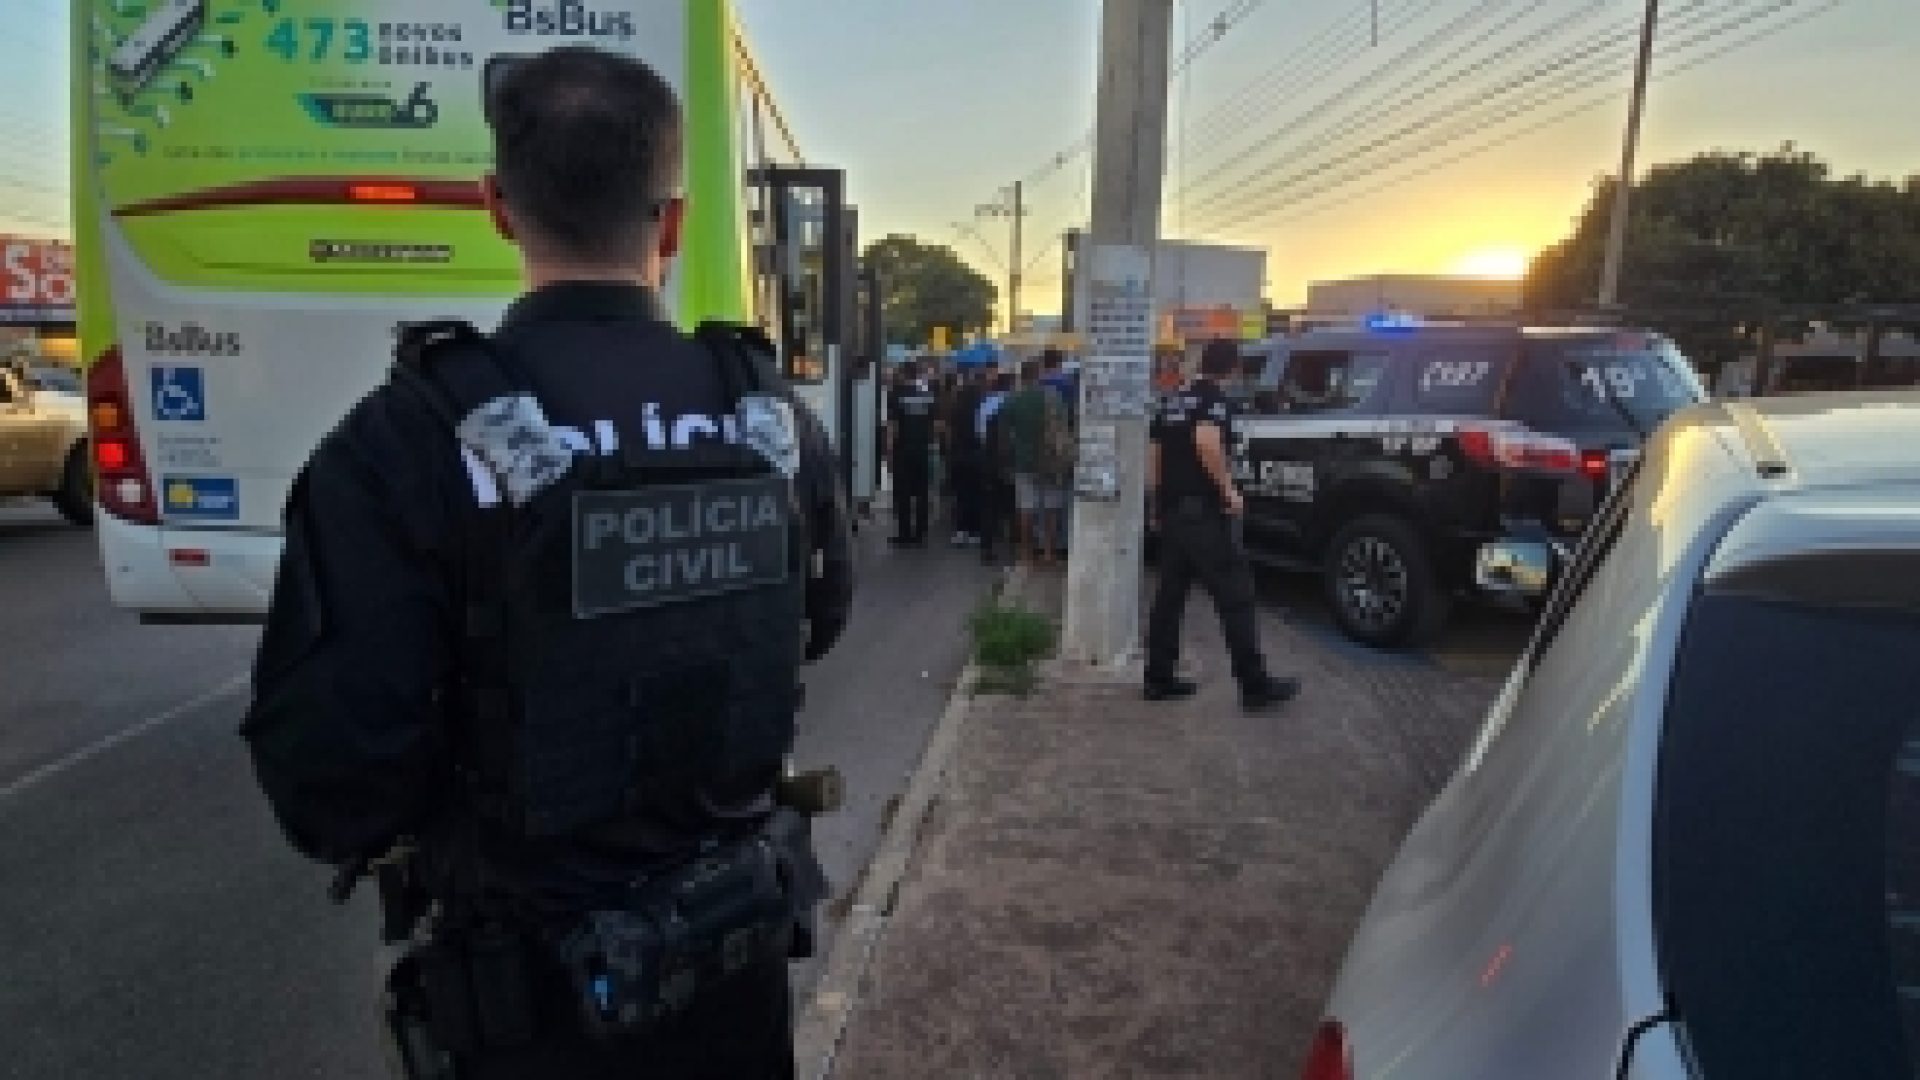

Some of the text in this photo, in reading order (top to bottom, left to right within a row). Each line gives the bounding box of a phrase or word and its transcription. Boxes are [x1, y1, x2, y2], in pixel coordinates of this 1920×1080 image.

[264, 18, 372, 62] 473
[505, 0, 636, 38] BsBus
[585, 488, 781, 550] POLÍCIA
[624, 542, 752, 592] CIVIL
